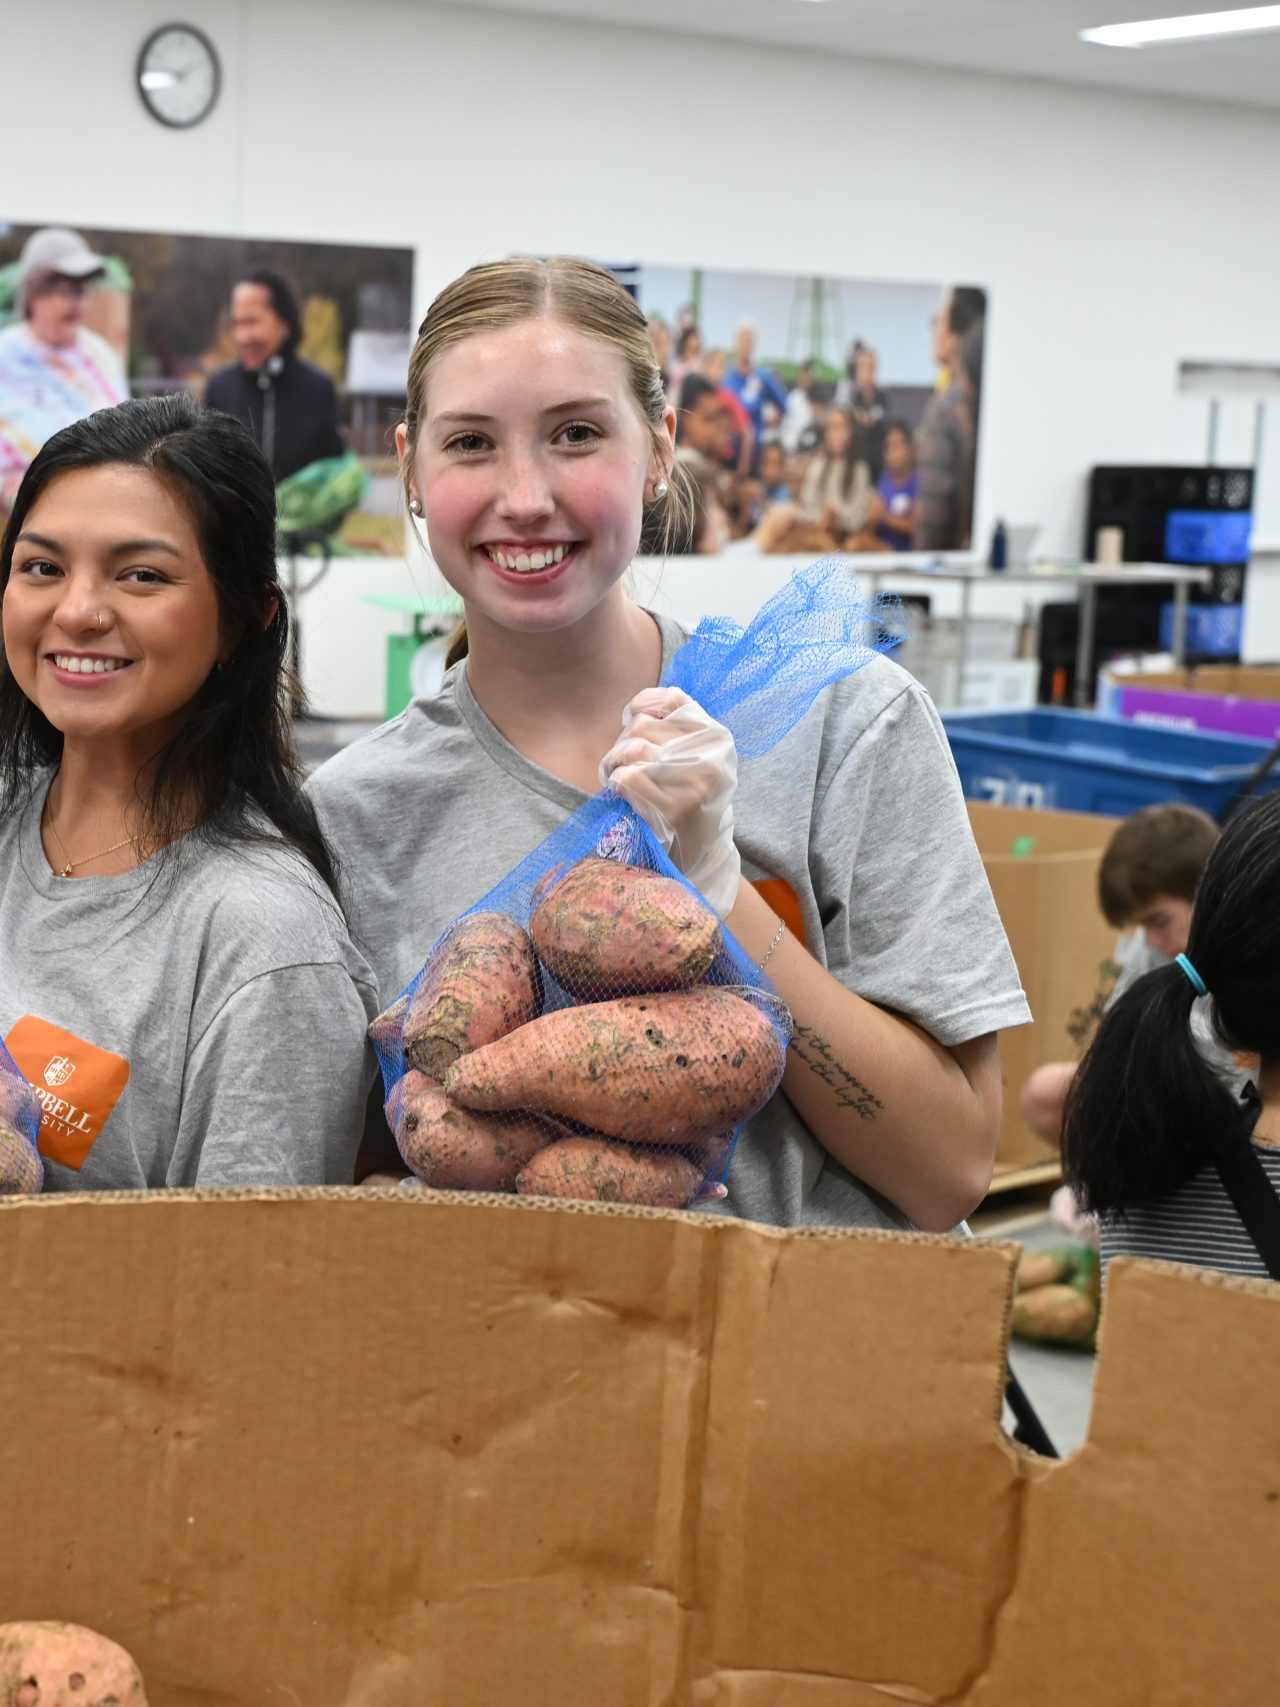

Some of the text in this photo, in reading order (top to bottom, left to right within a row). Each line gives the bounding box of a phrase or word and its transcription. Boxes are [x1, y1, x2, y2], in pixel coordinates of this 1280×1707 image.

[809, 1034, 833, 1061] the
[31, 1084, 91, 1133] PBELL
[810, 1062, 835, 1086] the
[834, 1087, 877, 1120] light
